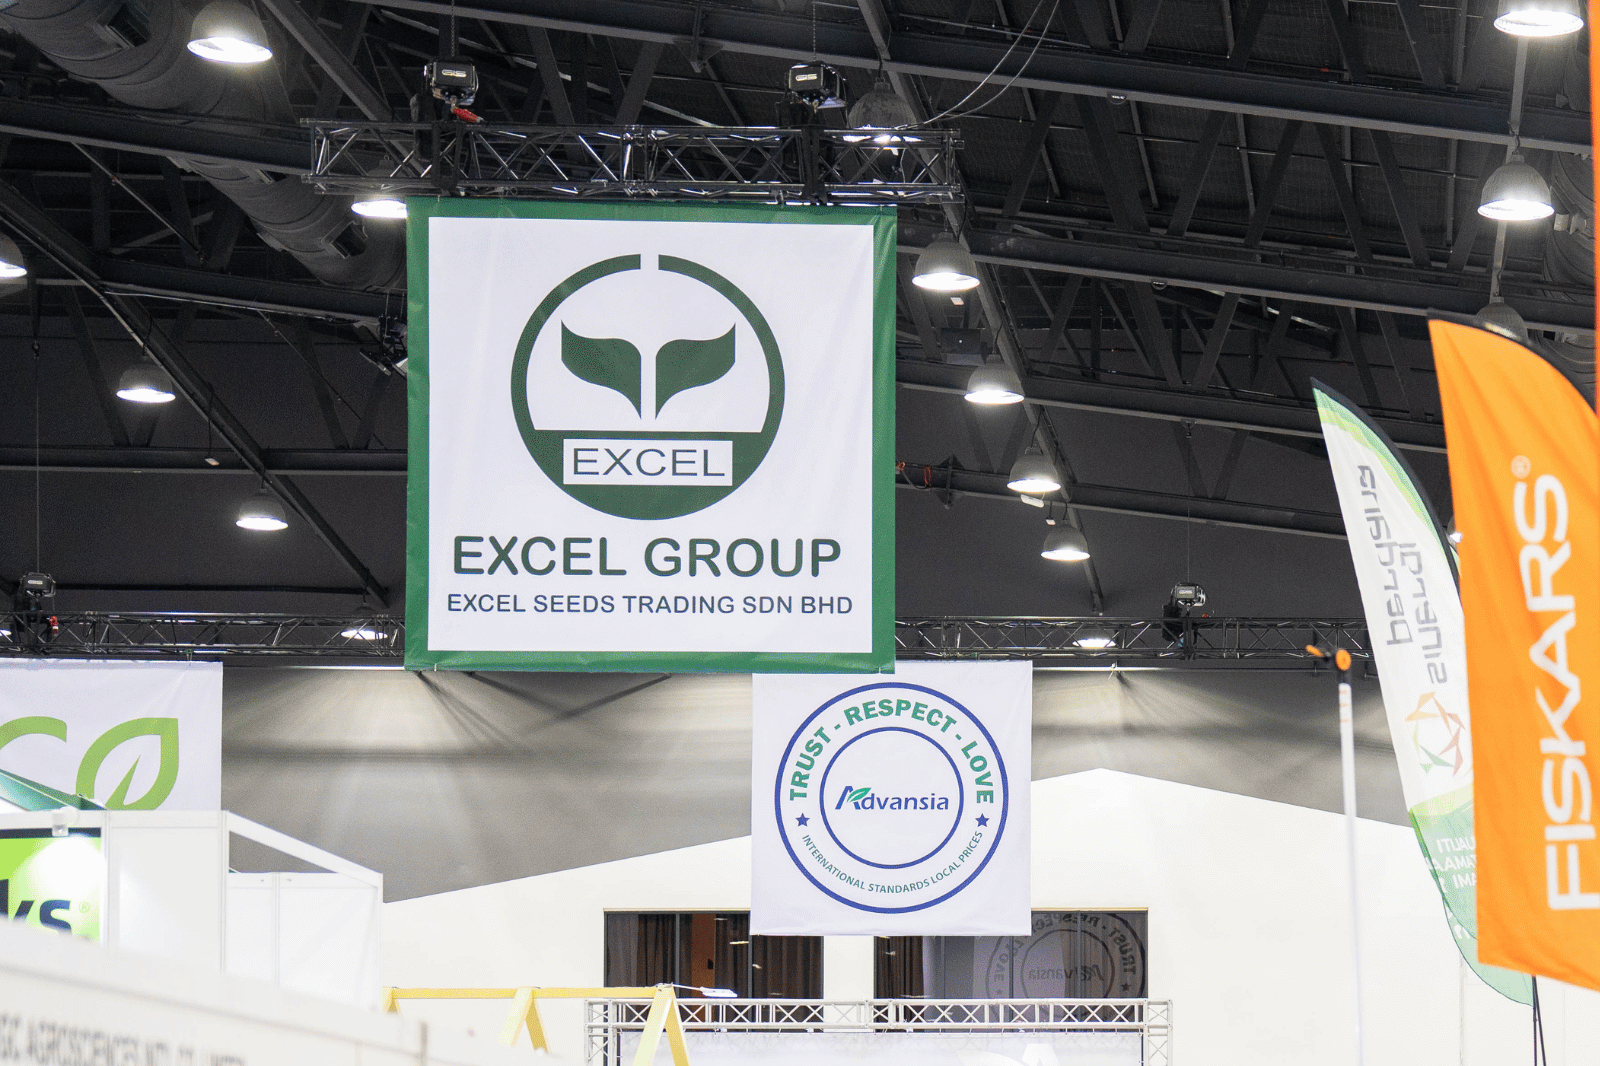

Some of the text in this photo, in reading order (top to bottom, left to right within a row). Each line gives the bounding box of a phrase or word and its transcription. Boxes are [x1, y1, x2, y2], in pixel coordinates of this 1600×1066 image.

[573, 447, 725, 478] EXCEL
[454, 535, 841, 578] EXCEL GROUP
[447, 593, 853, 615] EXCEL SEEDS TRADING SDN BHD
[789, 698, 994, 804] TRUST RESPECT LOVE
[835, 785, 949, 811] Advansia
[802, 831, 983, 894] INTERNATIONAL STANDARDS LOCAL PRICES
